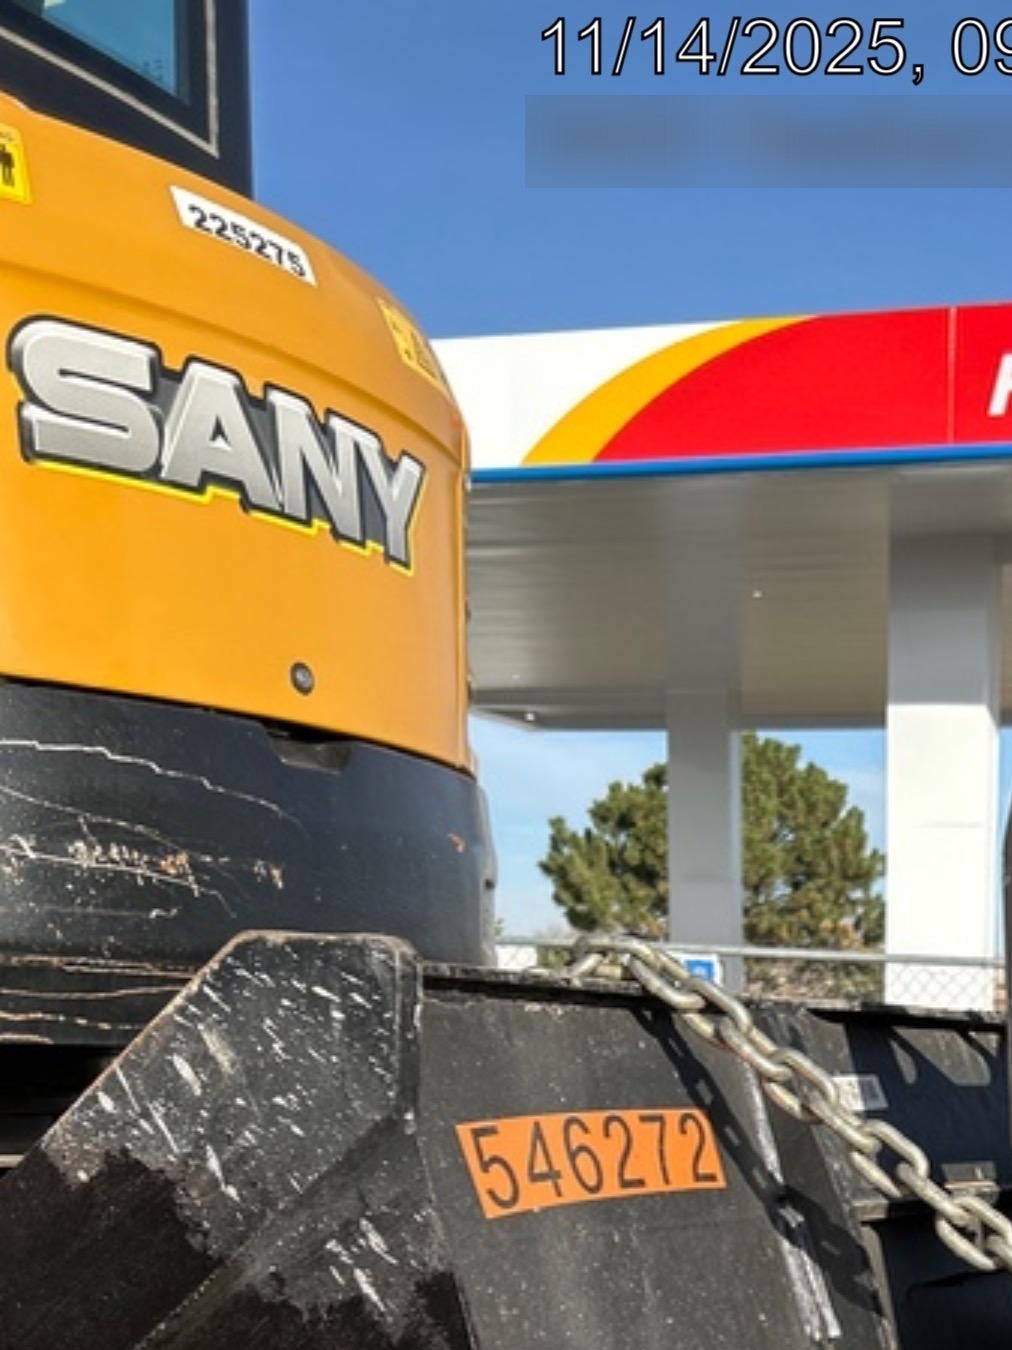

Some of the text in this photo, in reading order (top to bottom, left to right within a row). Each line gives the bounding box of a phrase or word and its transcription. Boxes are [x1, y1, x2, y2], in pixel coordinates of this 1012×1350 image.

[188, 203, 307, 278] 225275
[8, 316, 426, 572] SANY
[468, 1112, 719, 1210] 546272
